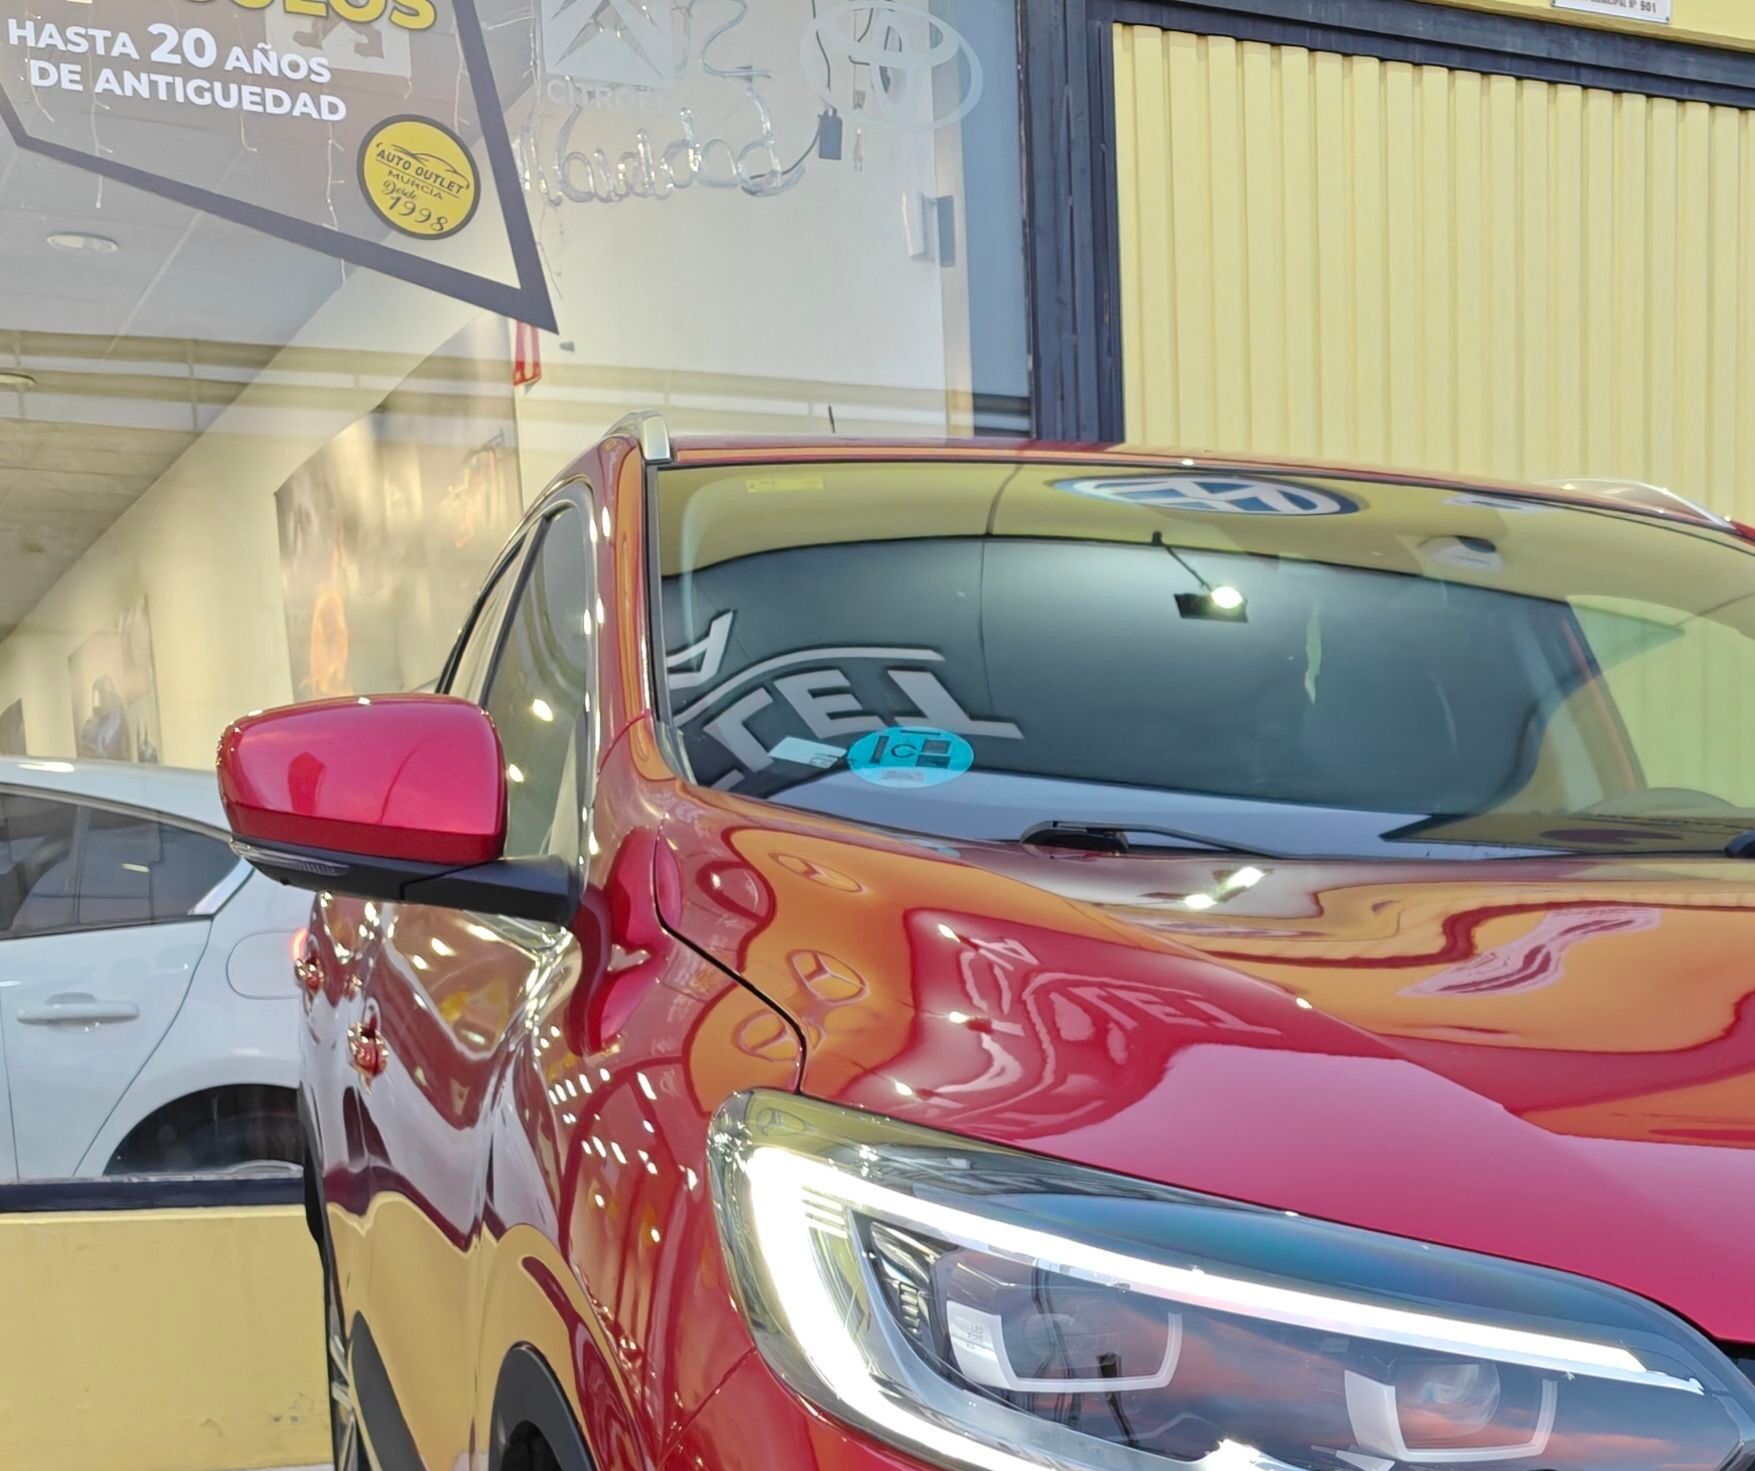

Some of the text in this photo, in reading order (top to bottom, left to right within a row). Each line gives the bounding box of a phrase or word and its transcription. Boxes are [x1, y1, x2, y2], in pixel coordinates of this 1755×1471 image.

[8, 18, 332, 83] HASTA 20 AÑOS
[30, 59, 347, 121] DE ANTIGUEDAD
[376, 149, 465, 195] AUTO OUTLET
[387, 170, 444, 201] MURCIA
[389, 196, 448, 232] 1998
